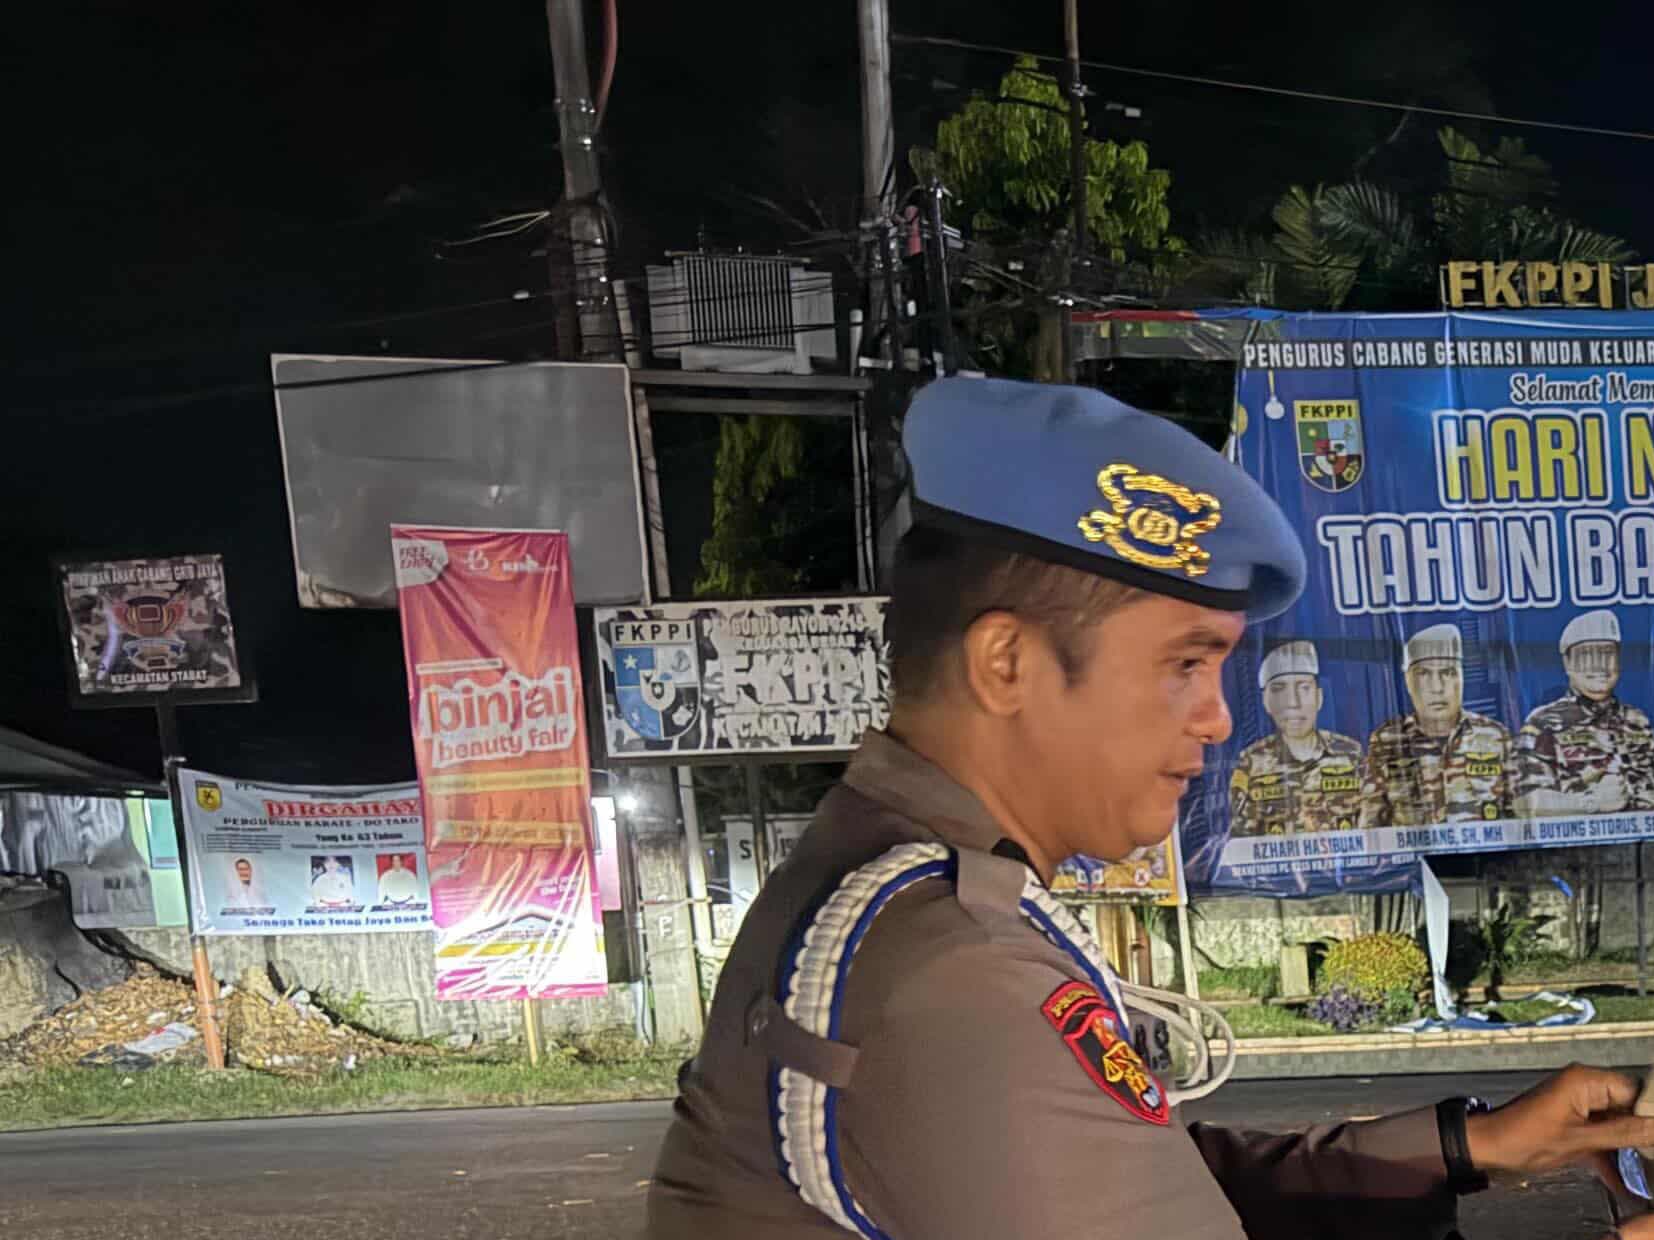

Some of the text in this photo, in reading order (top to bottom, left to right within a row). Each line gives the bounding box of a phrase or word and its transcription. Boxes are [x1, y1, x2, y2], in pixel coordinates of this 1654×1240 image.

[1450, 261, 1614, 309] FKPPI
[1244, 341, 1345, 369] PENGURUS
[1352, 341, 1427, 368] CABANG
[1434, 341, 1523, 367] GENERASI
[1531, 340, 1583, 365] MUDA
[1511, 373, 1602, 405] Selamat
[1300, 404, 1353, 418] FKPPI
[1438, 411, 1606, 505] HARI
[1320, 516, 1556, 613] TAHUN
[615, 623, 691, 642] FKPPI
[720, 650, 879, 704] FKPPI
[428, 672, 569, 736] binjai
[438, 726, 568, 760] beauty fair
[1253, 834, 1364, 860] AZHARI HASIBUAN
